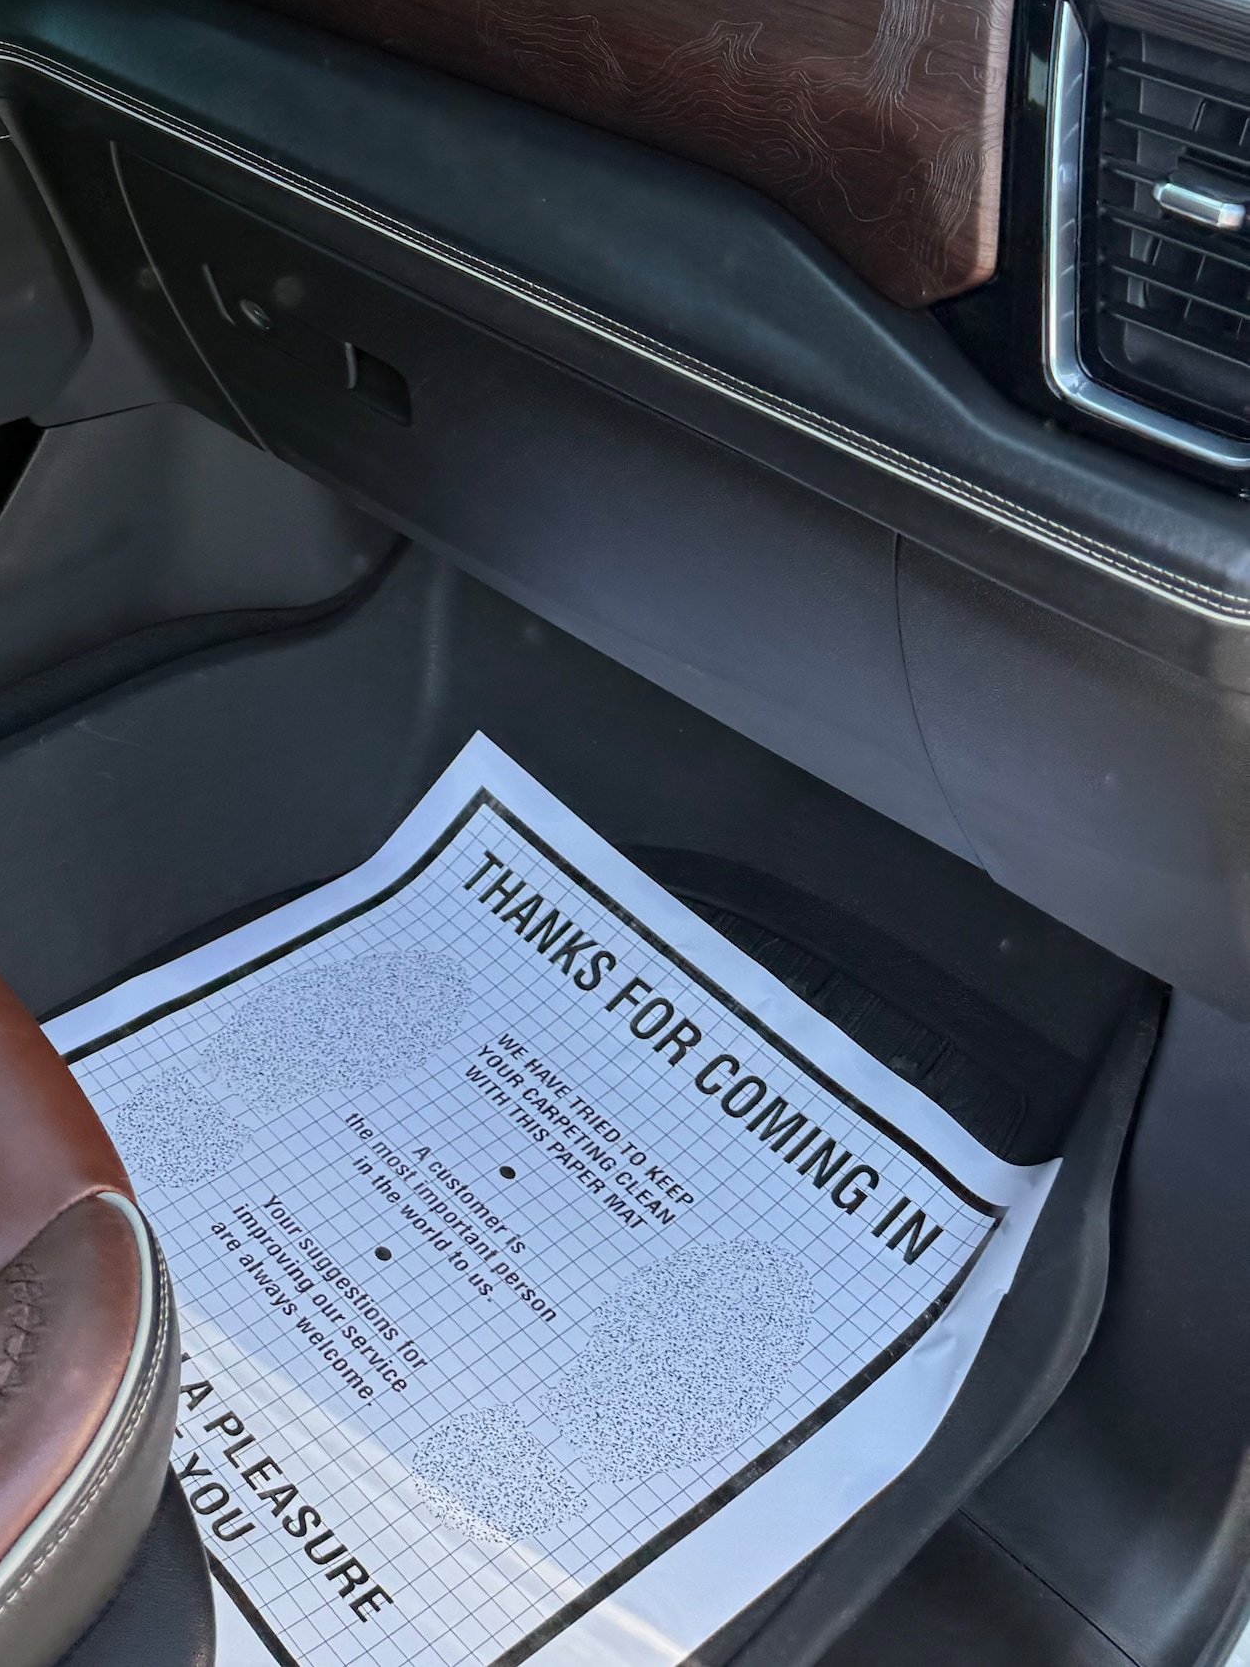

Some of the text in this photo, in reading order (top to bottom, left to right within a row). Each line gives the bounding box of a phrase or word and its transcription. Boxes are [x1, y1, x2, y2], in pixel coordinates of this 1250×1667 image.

[462, 850, 944, 1266] THANKS FOR COMING IN
[464, 1065, 648, 1229] WITH THIS PAPER MAT
[477, 1044, 676, 1226] YOUR CARPETING CLEAN
[498, 1033, 694, 1206] WE HAVE TRIED TO KEEP
[263, 1194, 428, 1369] Your suggestions for
[345, 1112, 557, 1323] the most important person
[352, 1155, 494, 1303] in the world to us.
[412, 1145, 526, 1254] A customer is
[211, 1222, 374, 1407] are always welcome.
[233, 1203, 408, 1393] improving our service
[178, 1452, 256, 1542] YOU
[180, 1380, 395, 1623] A PLEASURE
